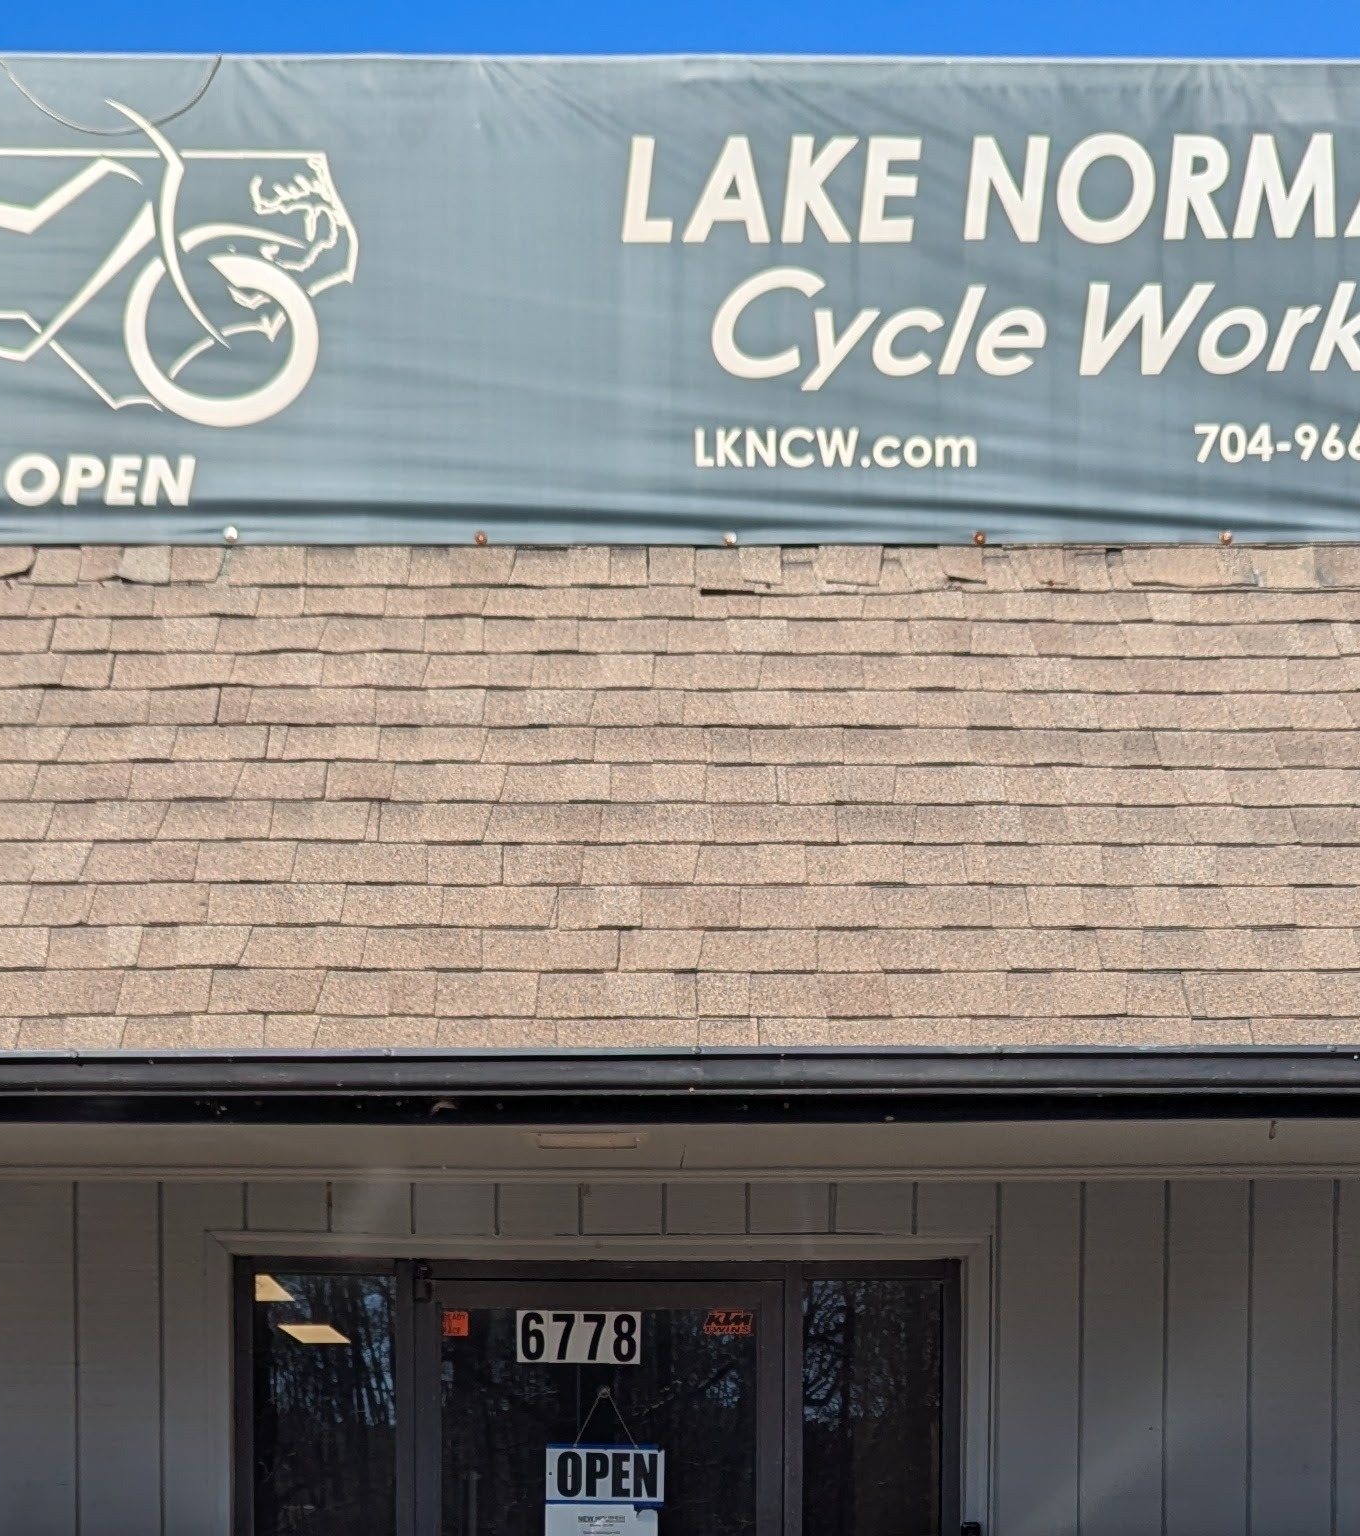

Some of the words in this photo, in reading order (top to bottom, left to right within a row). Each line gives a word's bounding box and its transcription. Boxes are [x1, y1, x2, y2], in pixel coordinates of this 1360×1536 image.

[621, 134, 922, 244] LAKE
[711, 267, 1047, 391] Cycle
[694, 427, 977, 468] LKNCW.com
[3, 452, 196, 506] OPEN
[520, 1311, 638, 1363] 6778
[705, 1311, 752, 1326] KTM
[557, 1451, 658, 1498] OPEN
